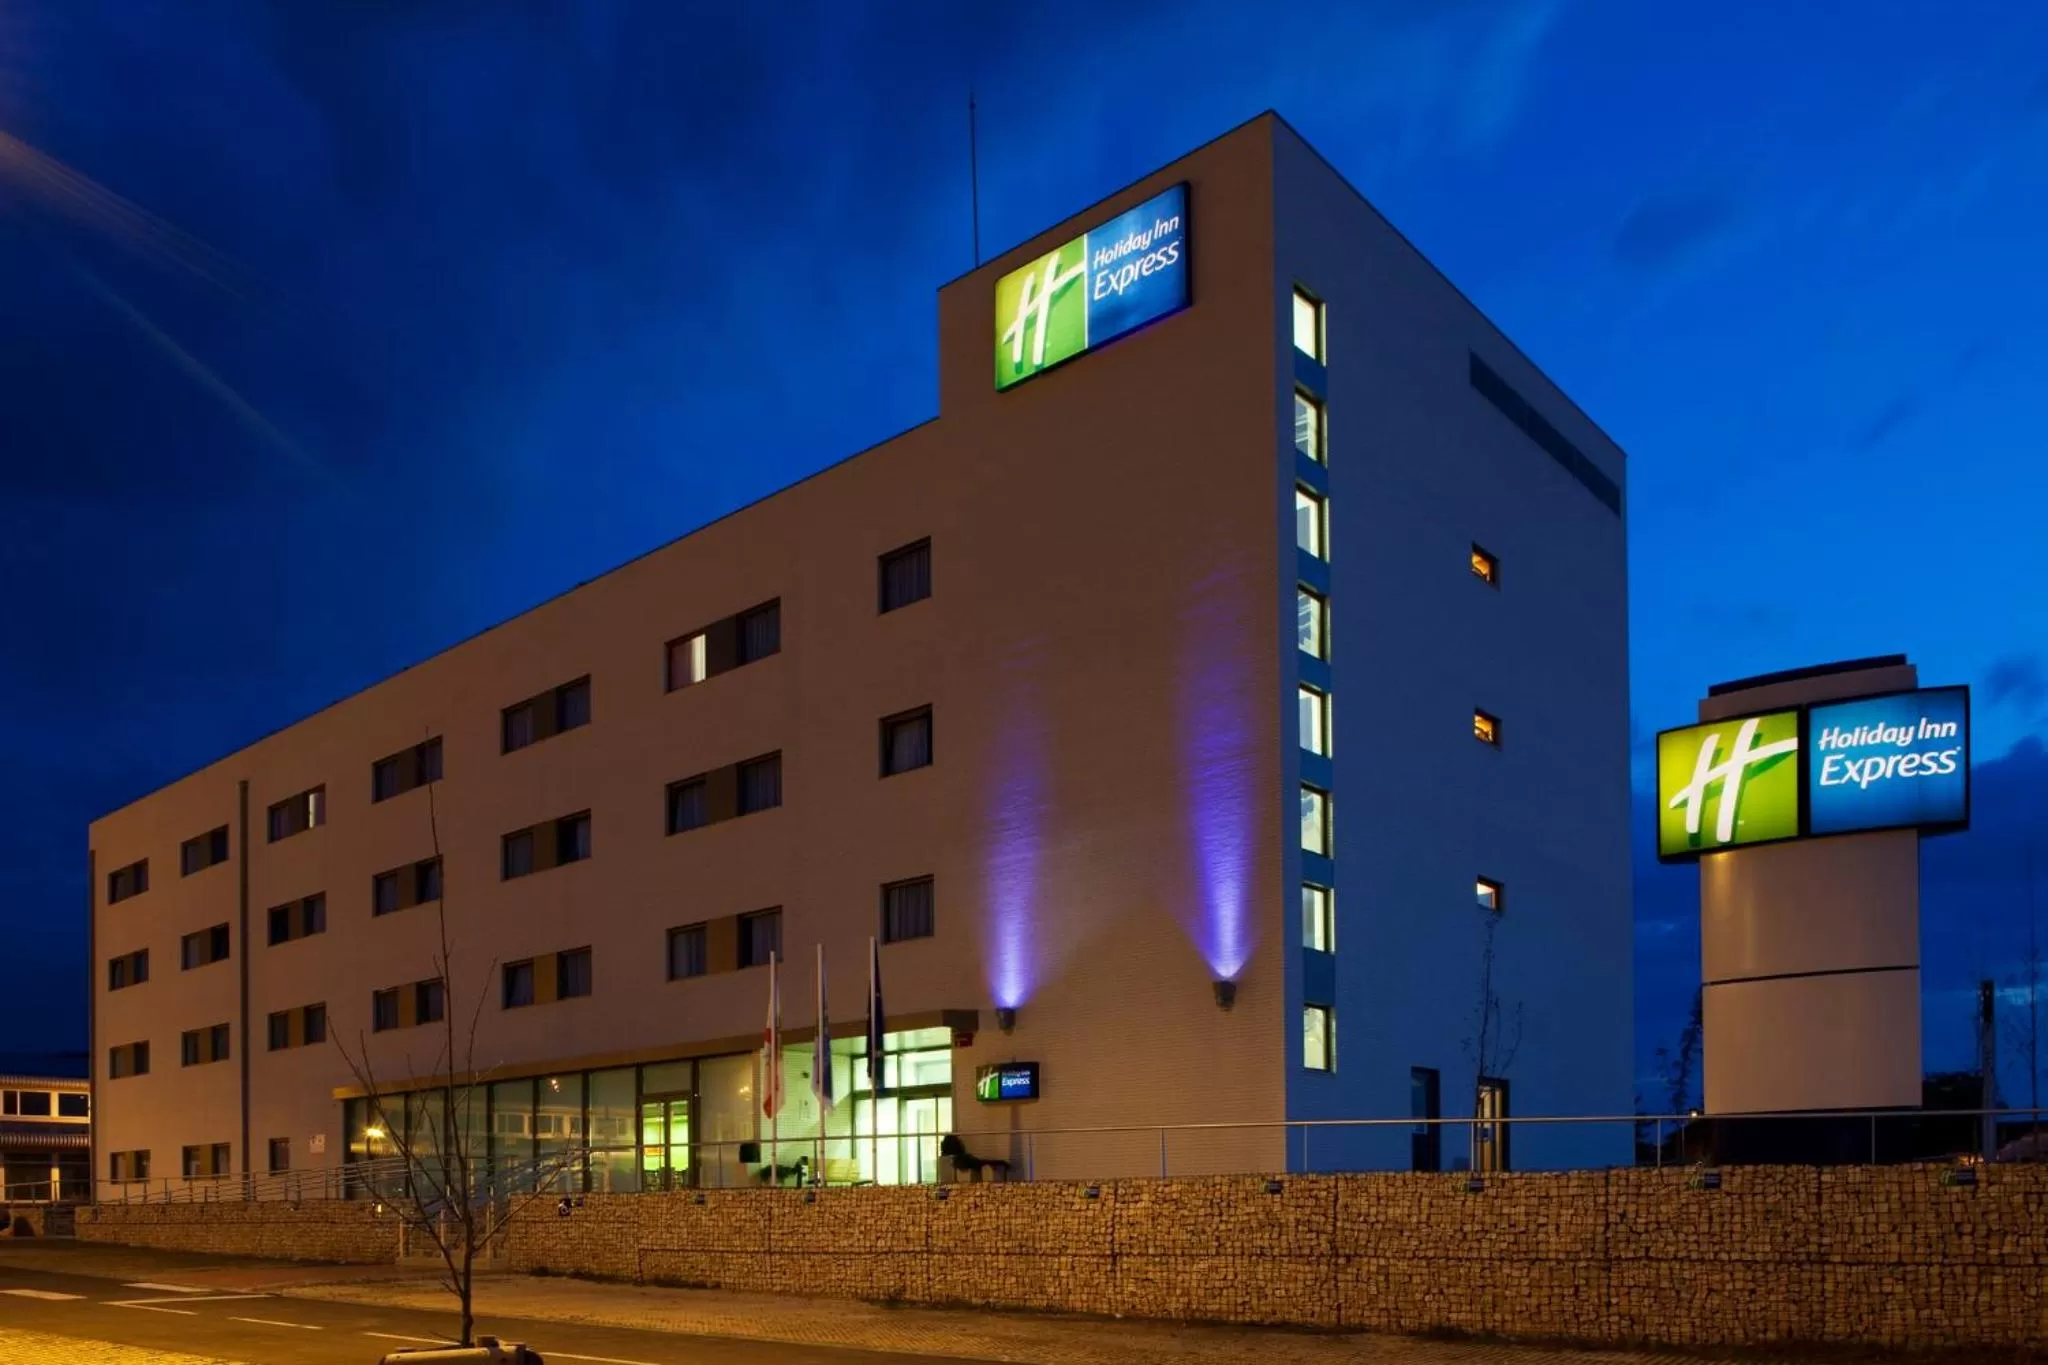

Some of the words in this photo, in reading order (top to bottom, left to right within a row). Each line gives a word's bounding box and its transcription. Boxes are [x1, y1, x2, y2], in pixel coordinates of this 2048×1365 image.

[1093, 230, 1153, 269] Holiday
[1154, 216, 1180, 240] Inn
[1094, 241, 1180, 301] Express
[1818, 720, 1914, 750] Holiday
[1918, 717, 1957, 740] Inn
[1820, 749, 1958, 789] Express
